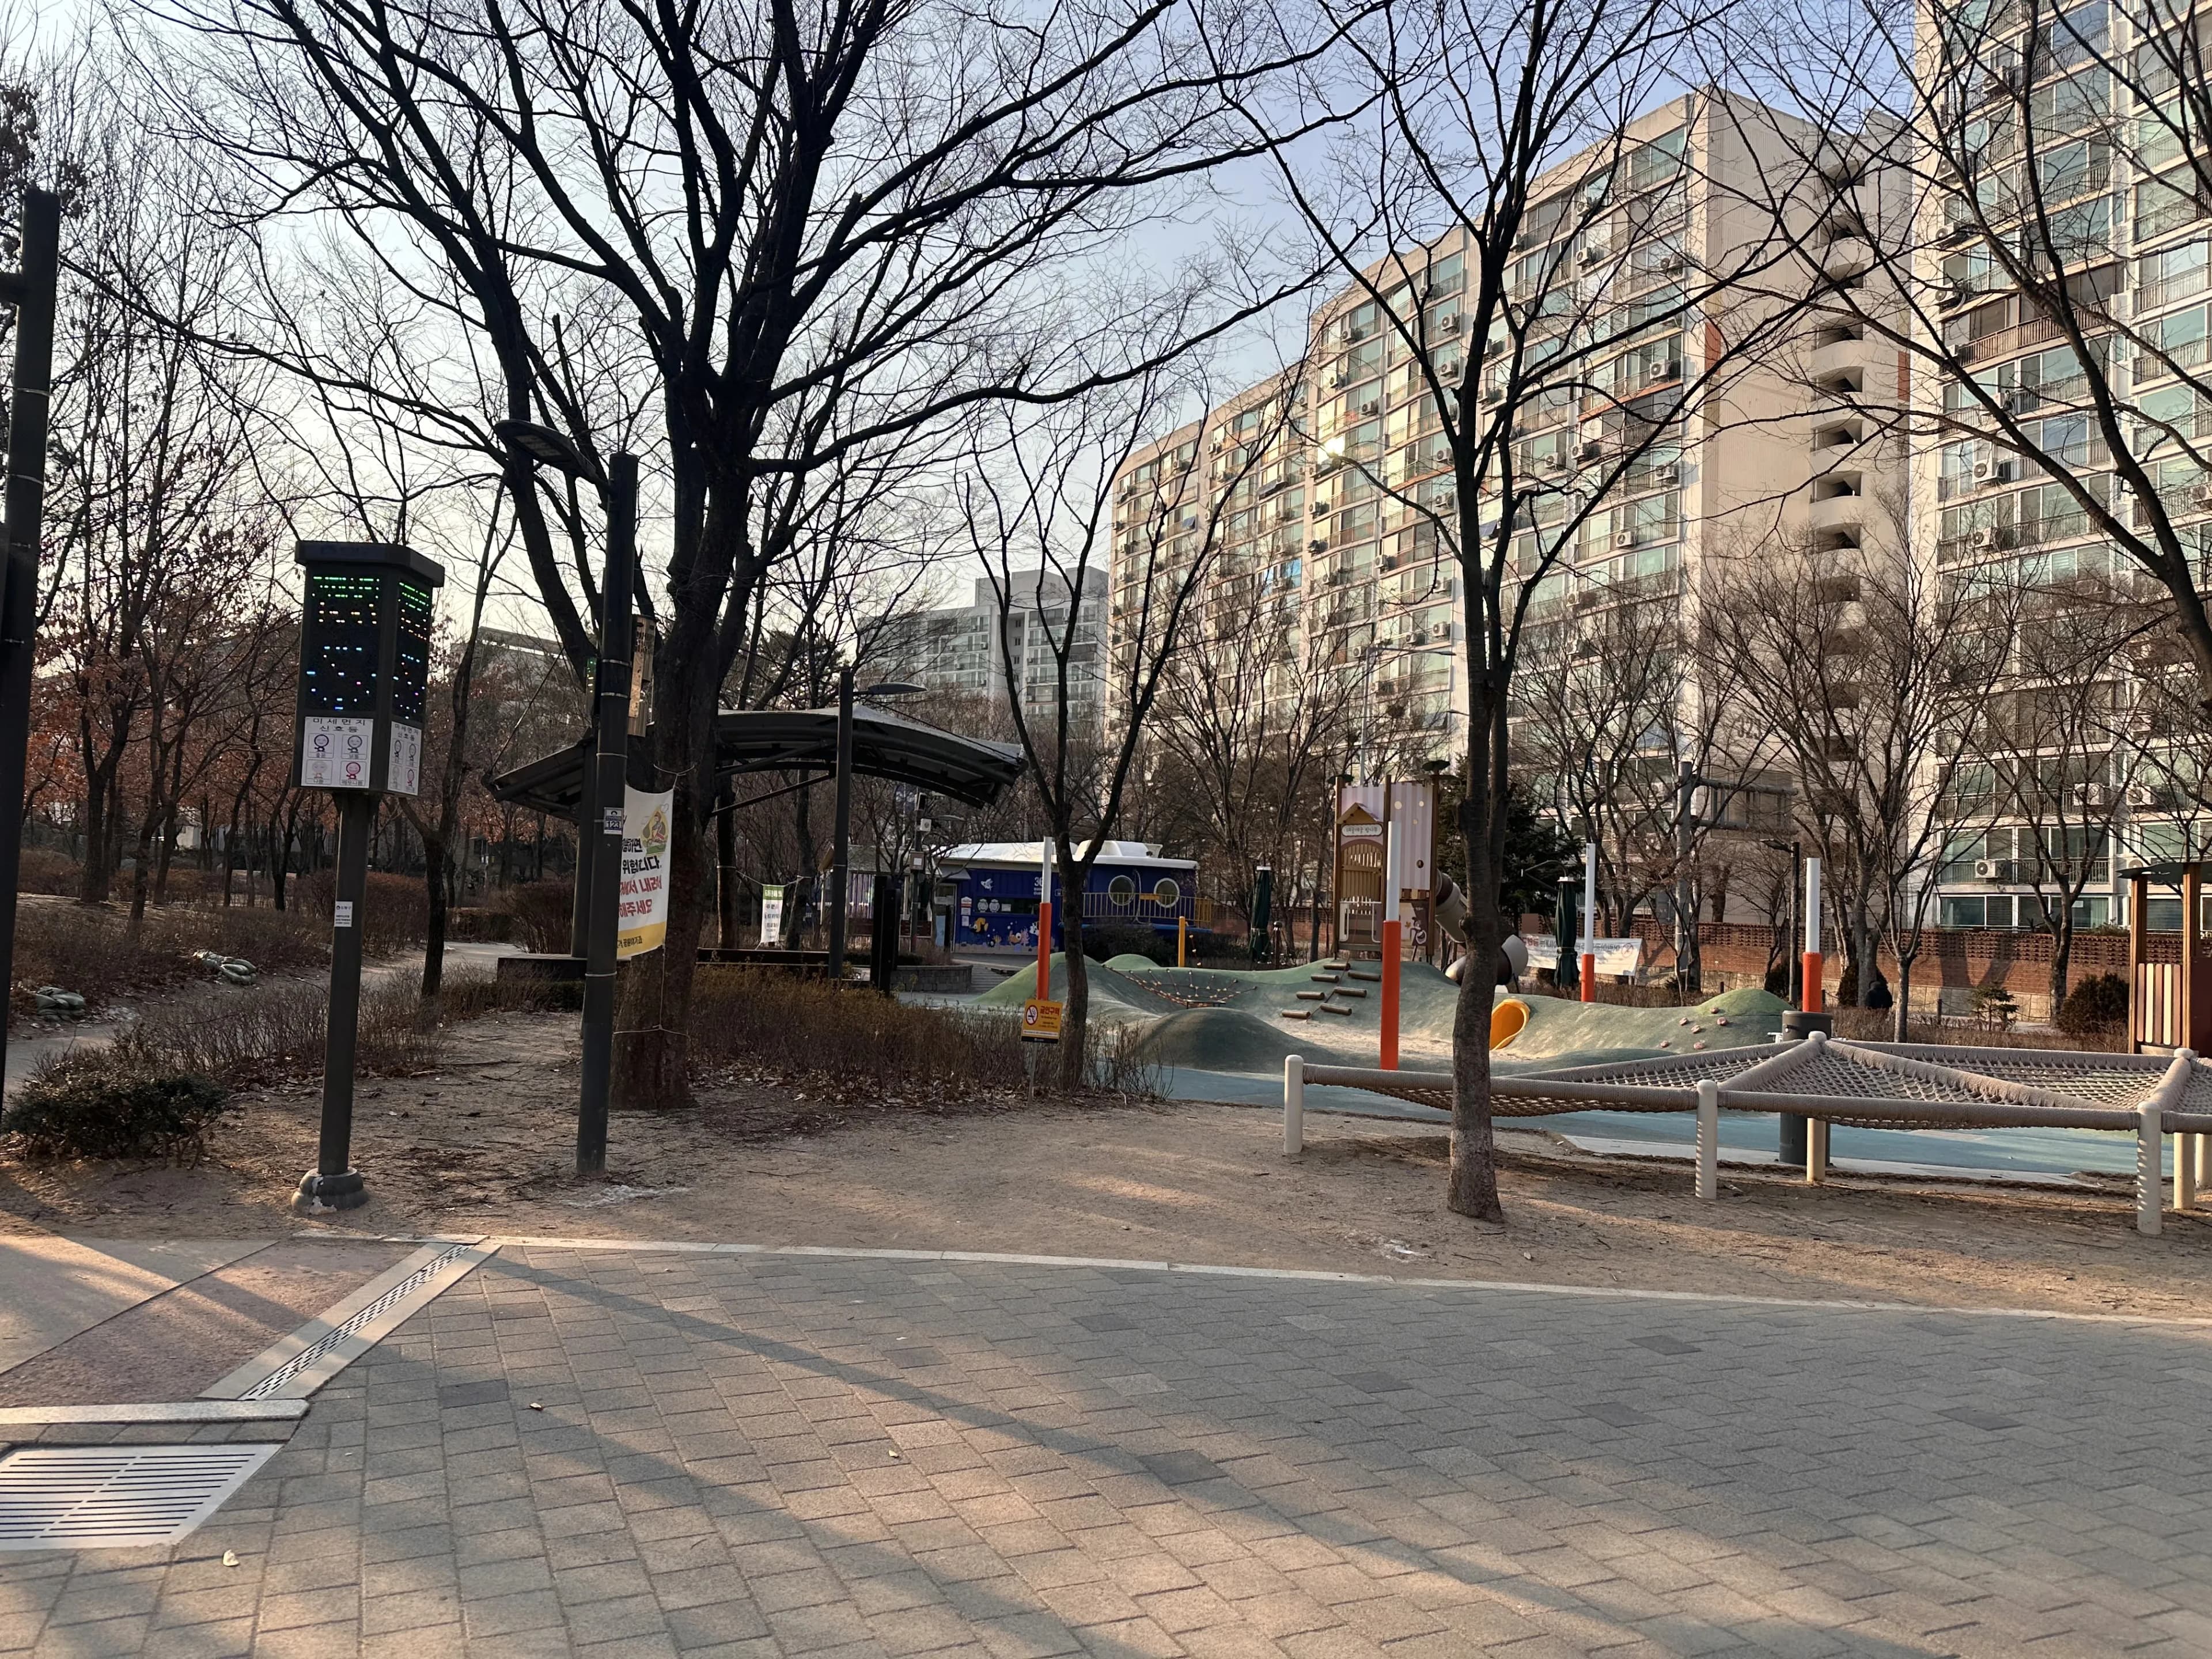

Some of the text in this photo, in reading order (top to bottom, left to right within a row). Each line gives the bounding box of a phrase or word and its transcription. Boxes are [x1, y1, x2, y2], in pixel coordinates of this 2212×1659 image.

[313, 718, 365, 726] 미세먼지
[319, 725, 359, 733] 신호등
[1040, 1006, 1060, 1016] 금연구역
